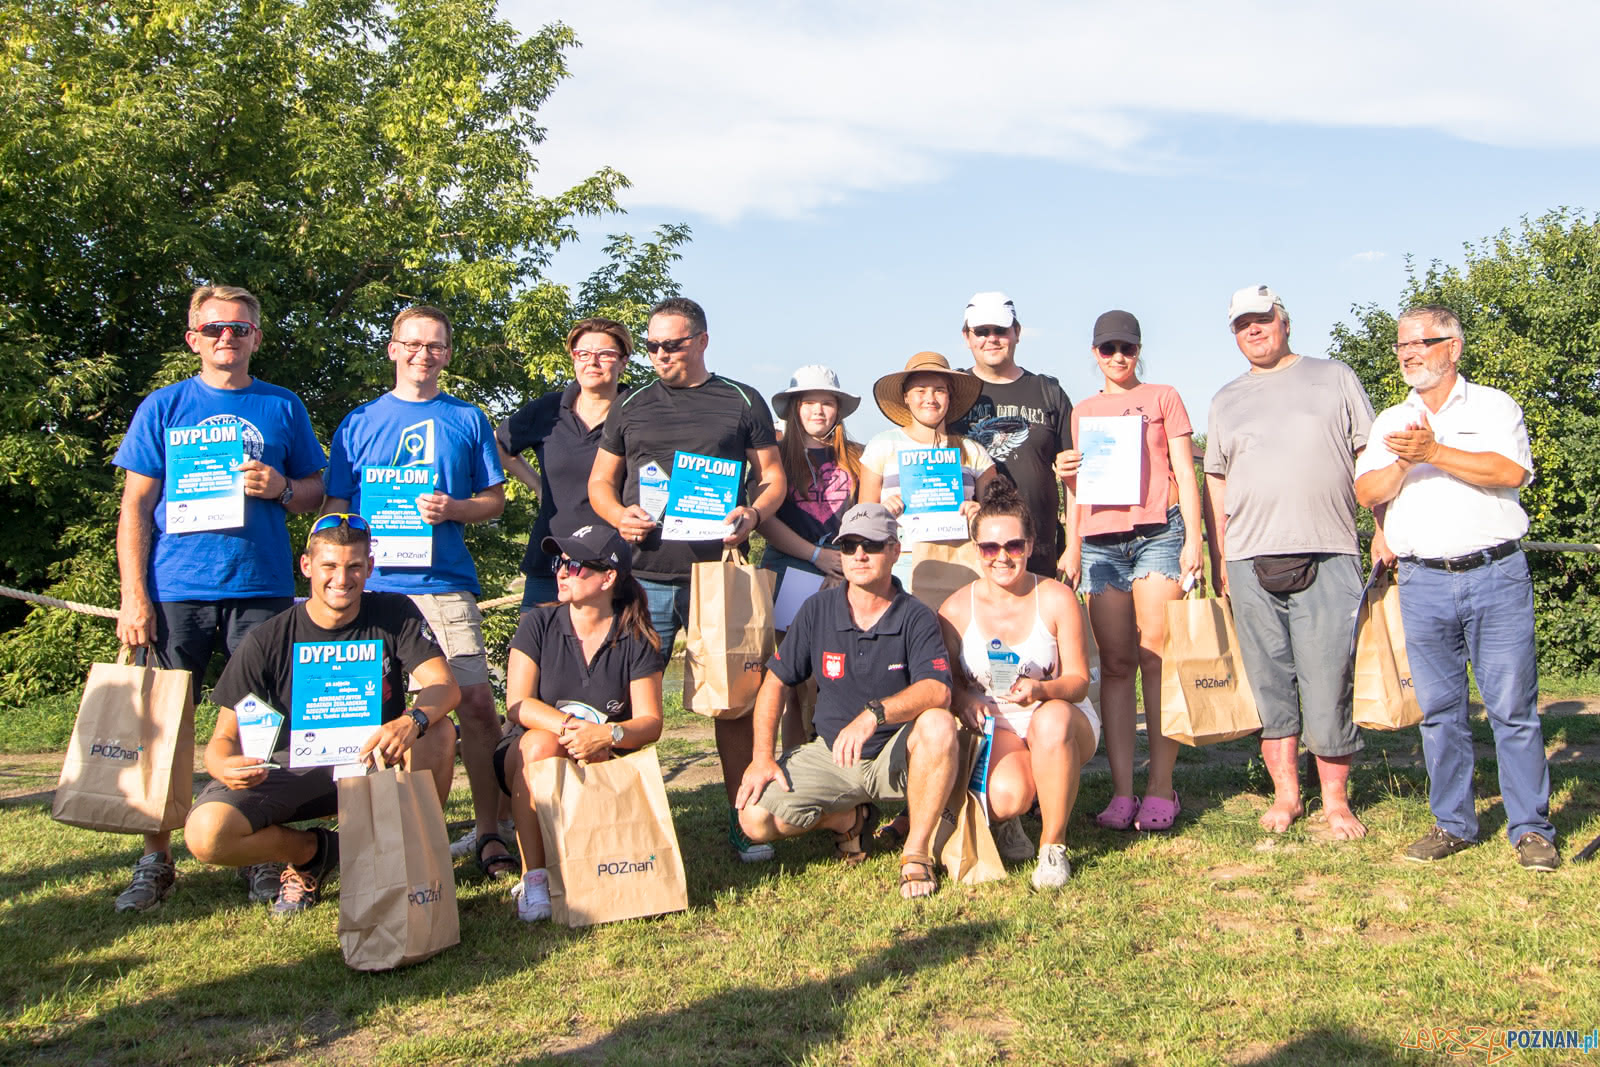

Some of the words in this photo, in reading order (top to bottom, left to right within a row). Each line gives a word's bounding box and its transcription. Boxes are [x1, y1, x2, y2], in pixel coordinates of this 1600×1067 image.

[170, 426, 237, 446] DYPLOM
[677, 454, 737, 477] DYPLOM
[902, 450, 956, 466] DYPLOM
[366, 468, 429, 484] DYPLOM
[299, 644, 376, 663] DYPLOM
